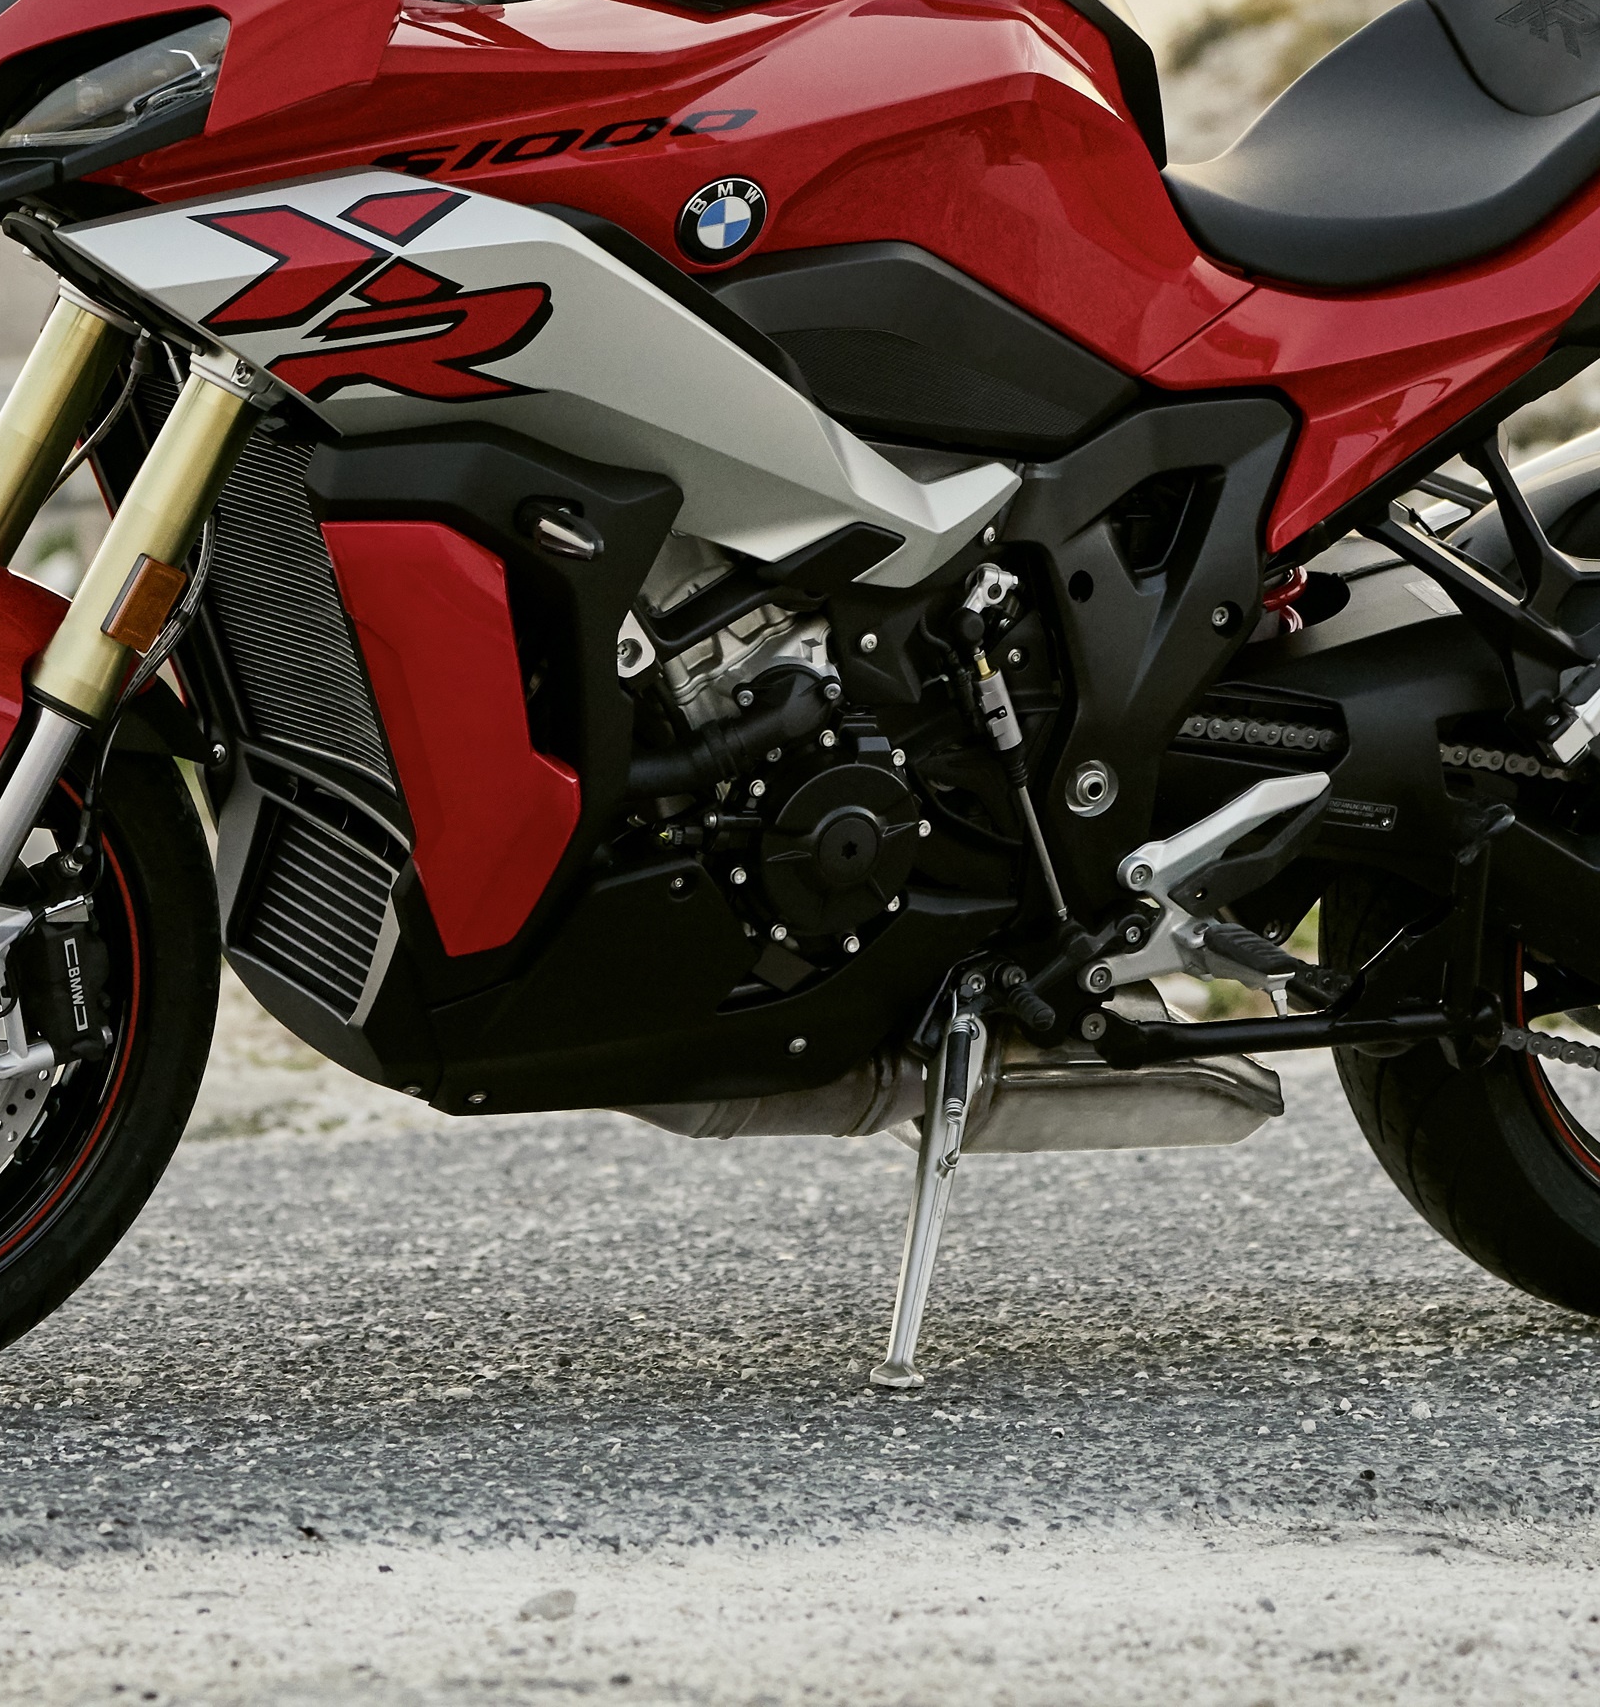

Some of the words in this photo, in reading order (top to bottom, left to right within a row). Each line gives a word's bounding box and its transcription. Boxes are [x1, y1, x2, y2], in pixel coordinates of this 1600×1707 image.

[688, 181, 761, 216] BMW
[187, 185, 554, 404] XR
[68, 966, 85, 1005] BMW
